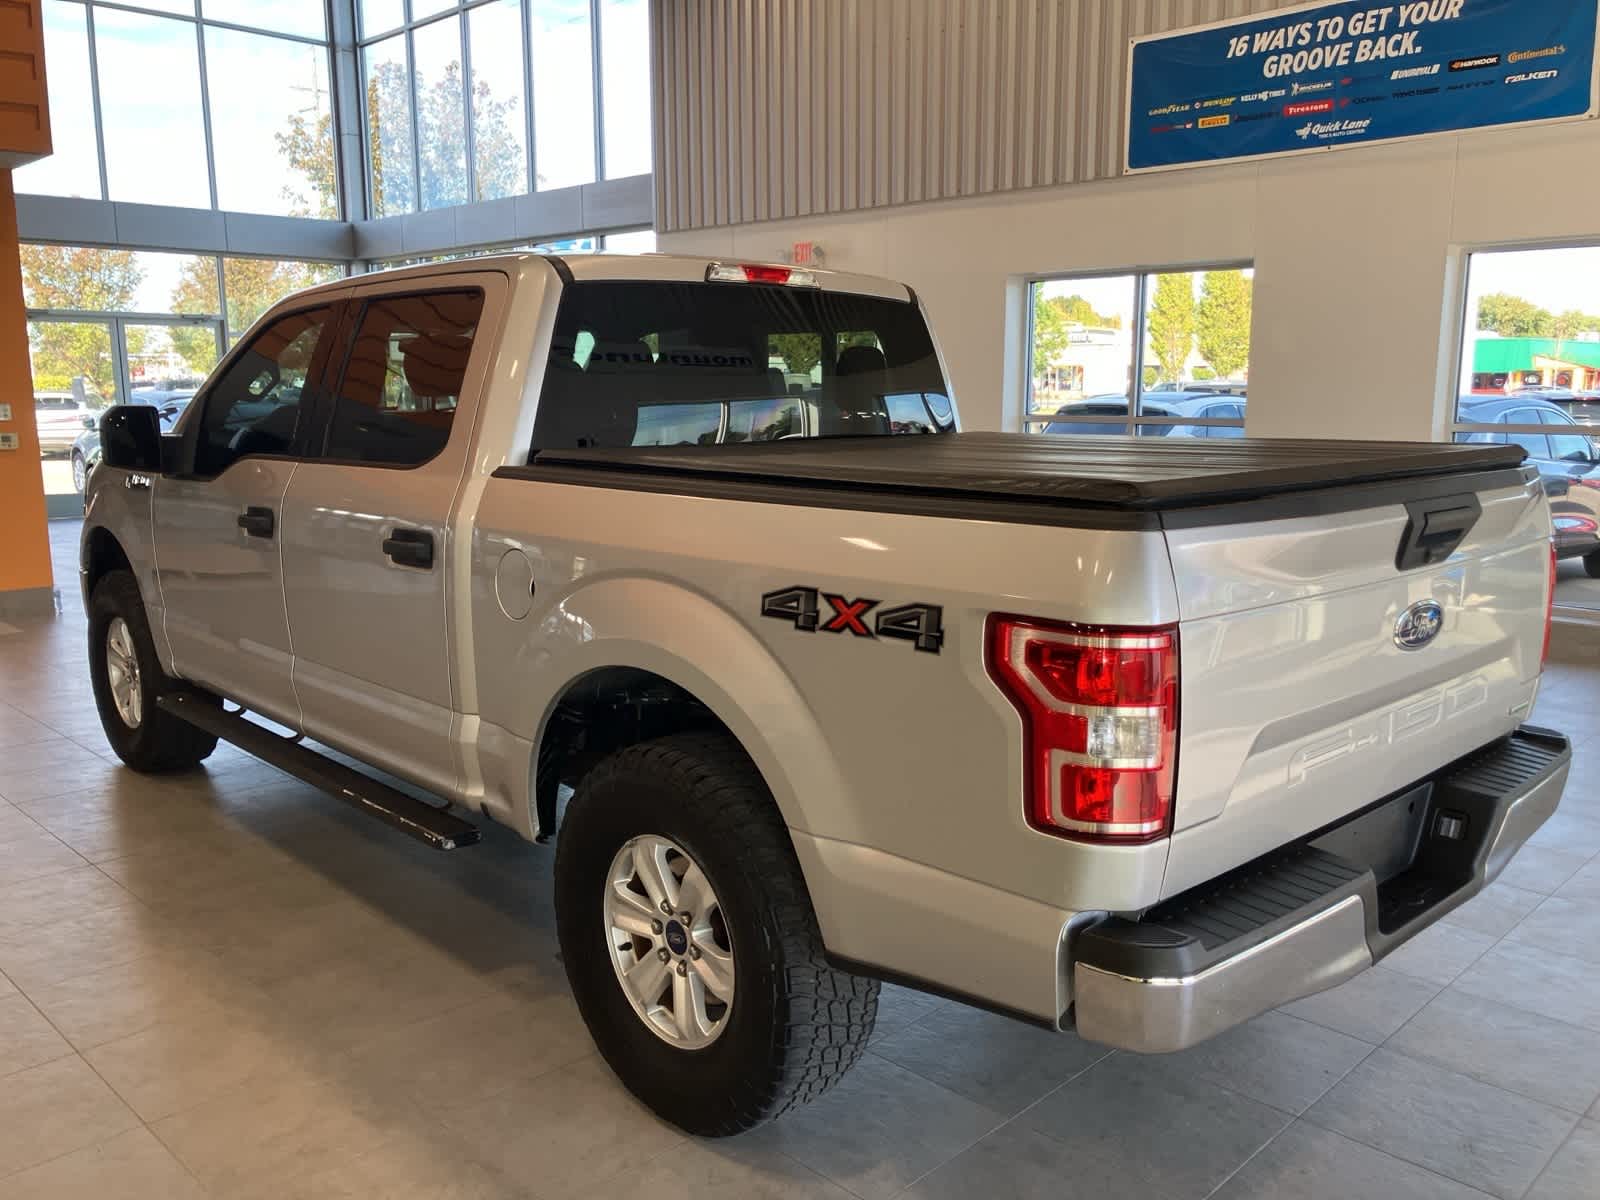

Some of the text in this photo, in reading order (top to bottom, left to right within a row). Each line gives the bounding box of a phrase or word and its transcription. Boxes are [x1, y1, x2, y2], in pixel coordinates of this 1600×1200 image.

[1226, 0, 1465, 59] 16 WAYS TO GET YOUR
[1263, 30, 1424, 79] GROOVE BACK.
[1504, 70, 1559, 85] FALKEN
[1288, 103, 1329, 115] Firestone
[1311, 119, 1371, 136] Quick Lane
[1287, 674, 1488, 789] F-150
